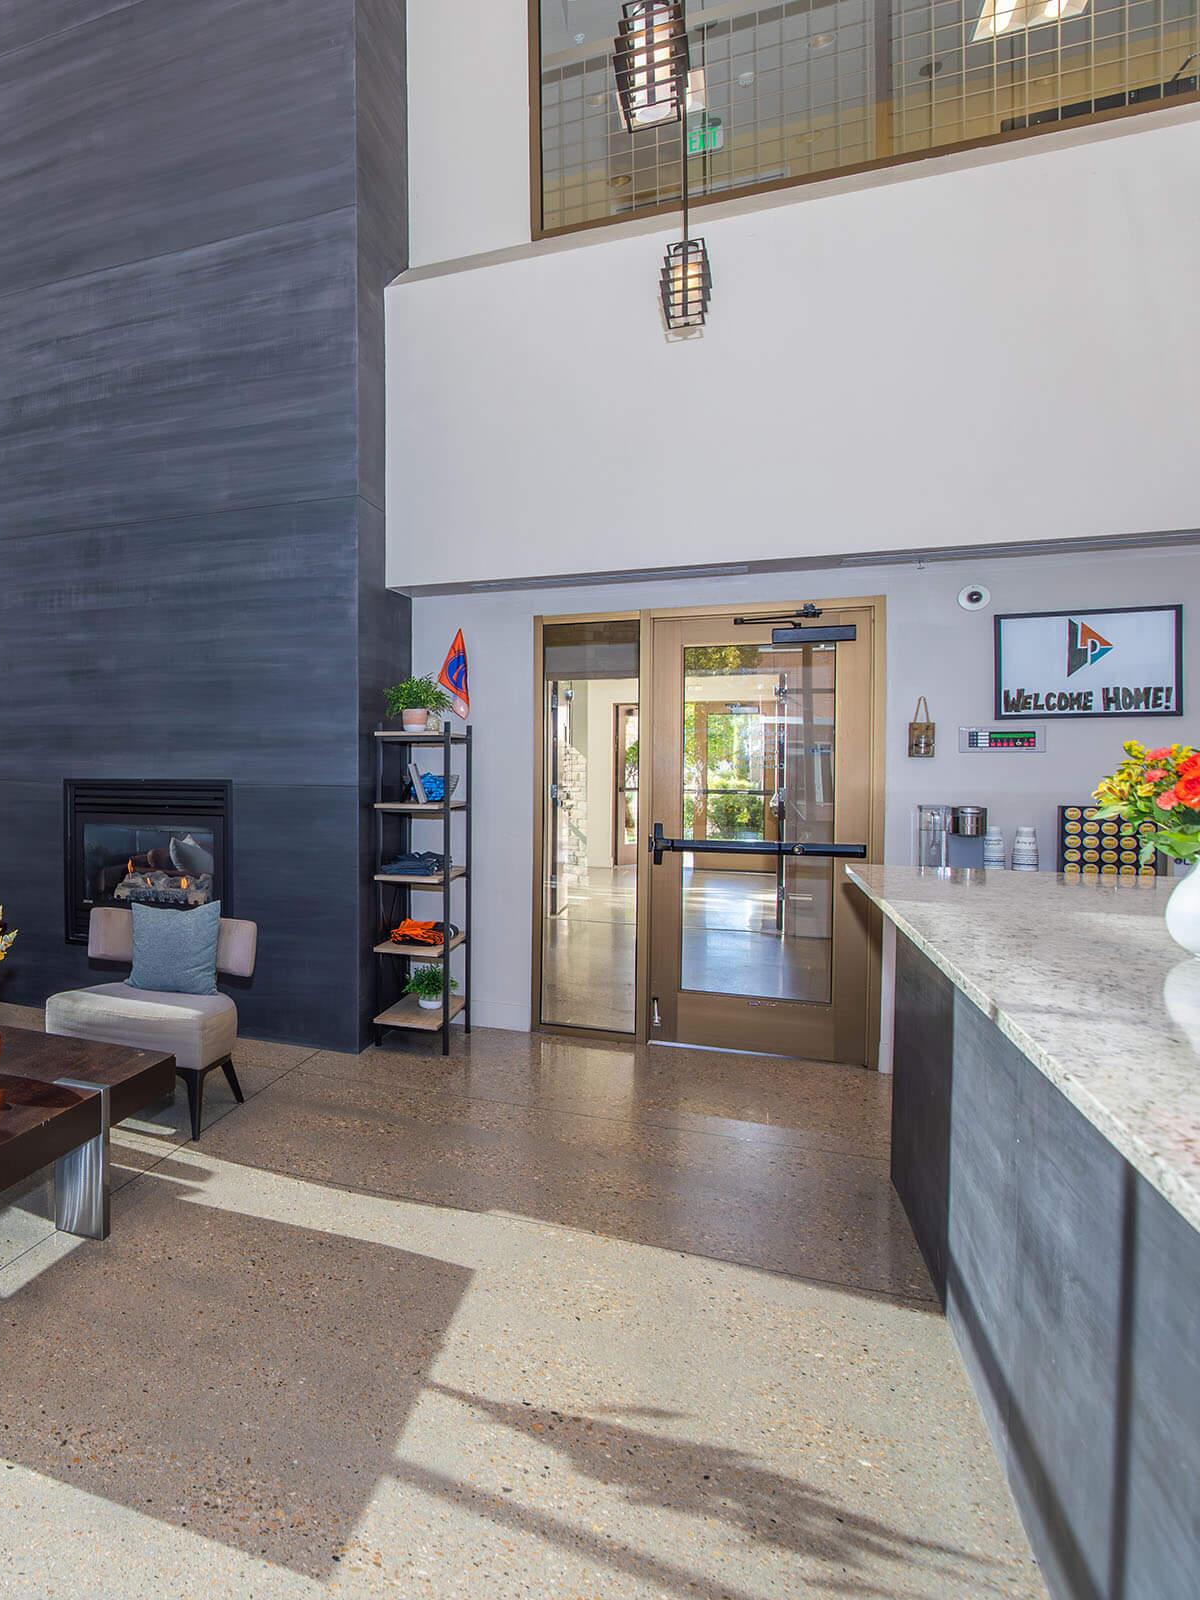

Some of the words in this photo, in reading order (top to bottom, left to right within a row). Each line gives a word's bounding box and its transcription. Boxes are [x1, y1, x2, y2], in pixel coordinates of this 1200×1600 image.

[688, 127, 718, 153] EXIT
[1003, 688, 1094, 713] WELCOME
[1102, 686, 1173, 712] HOME!
